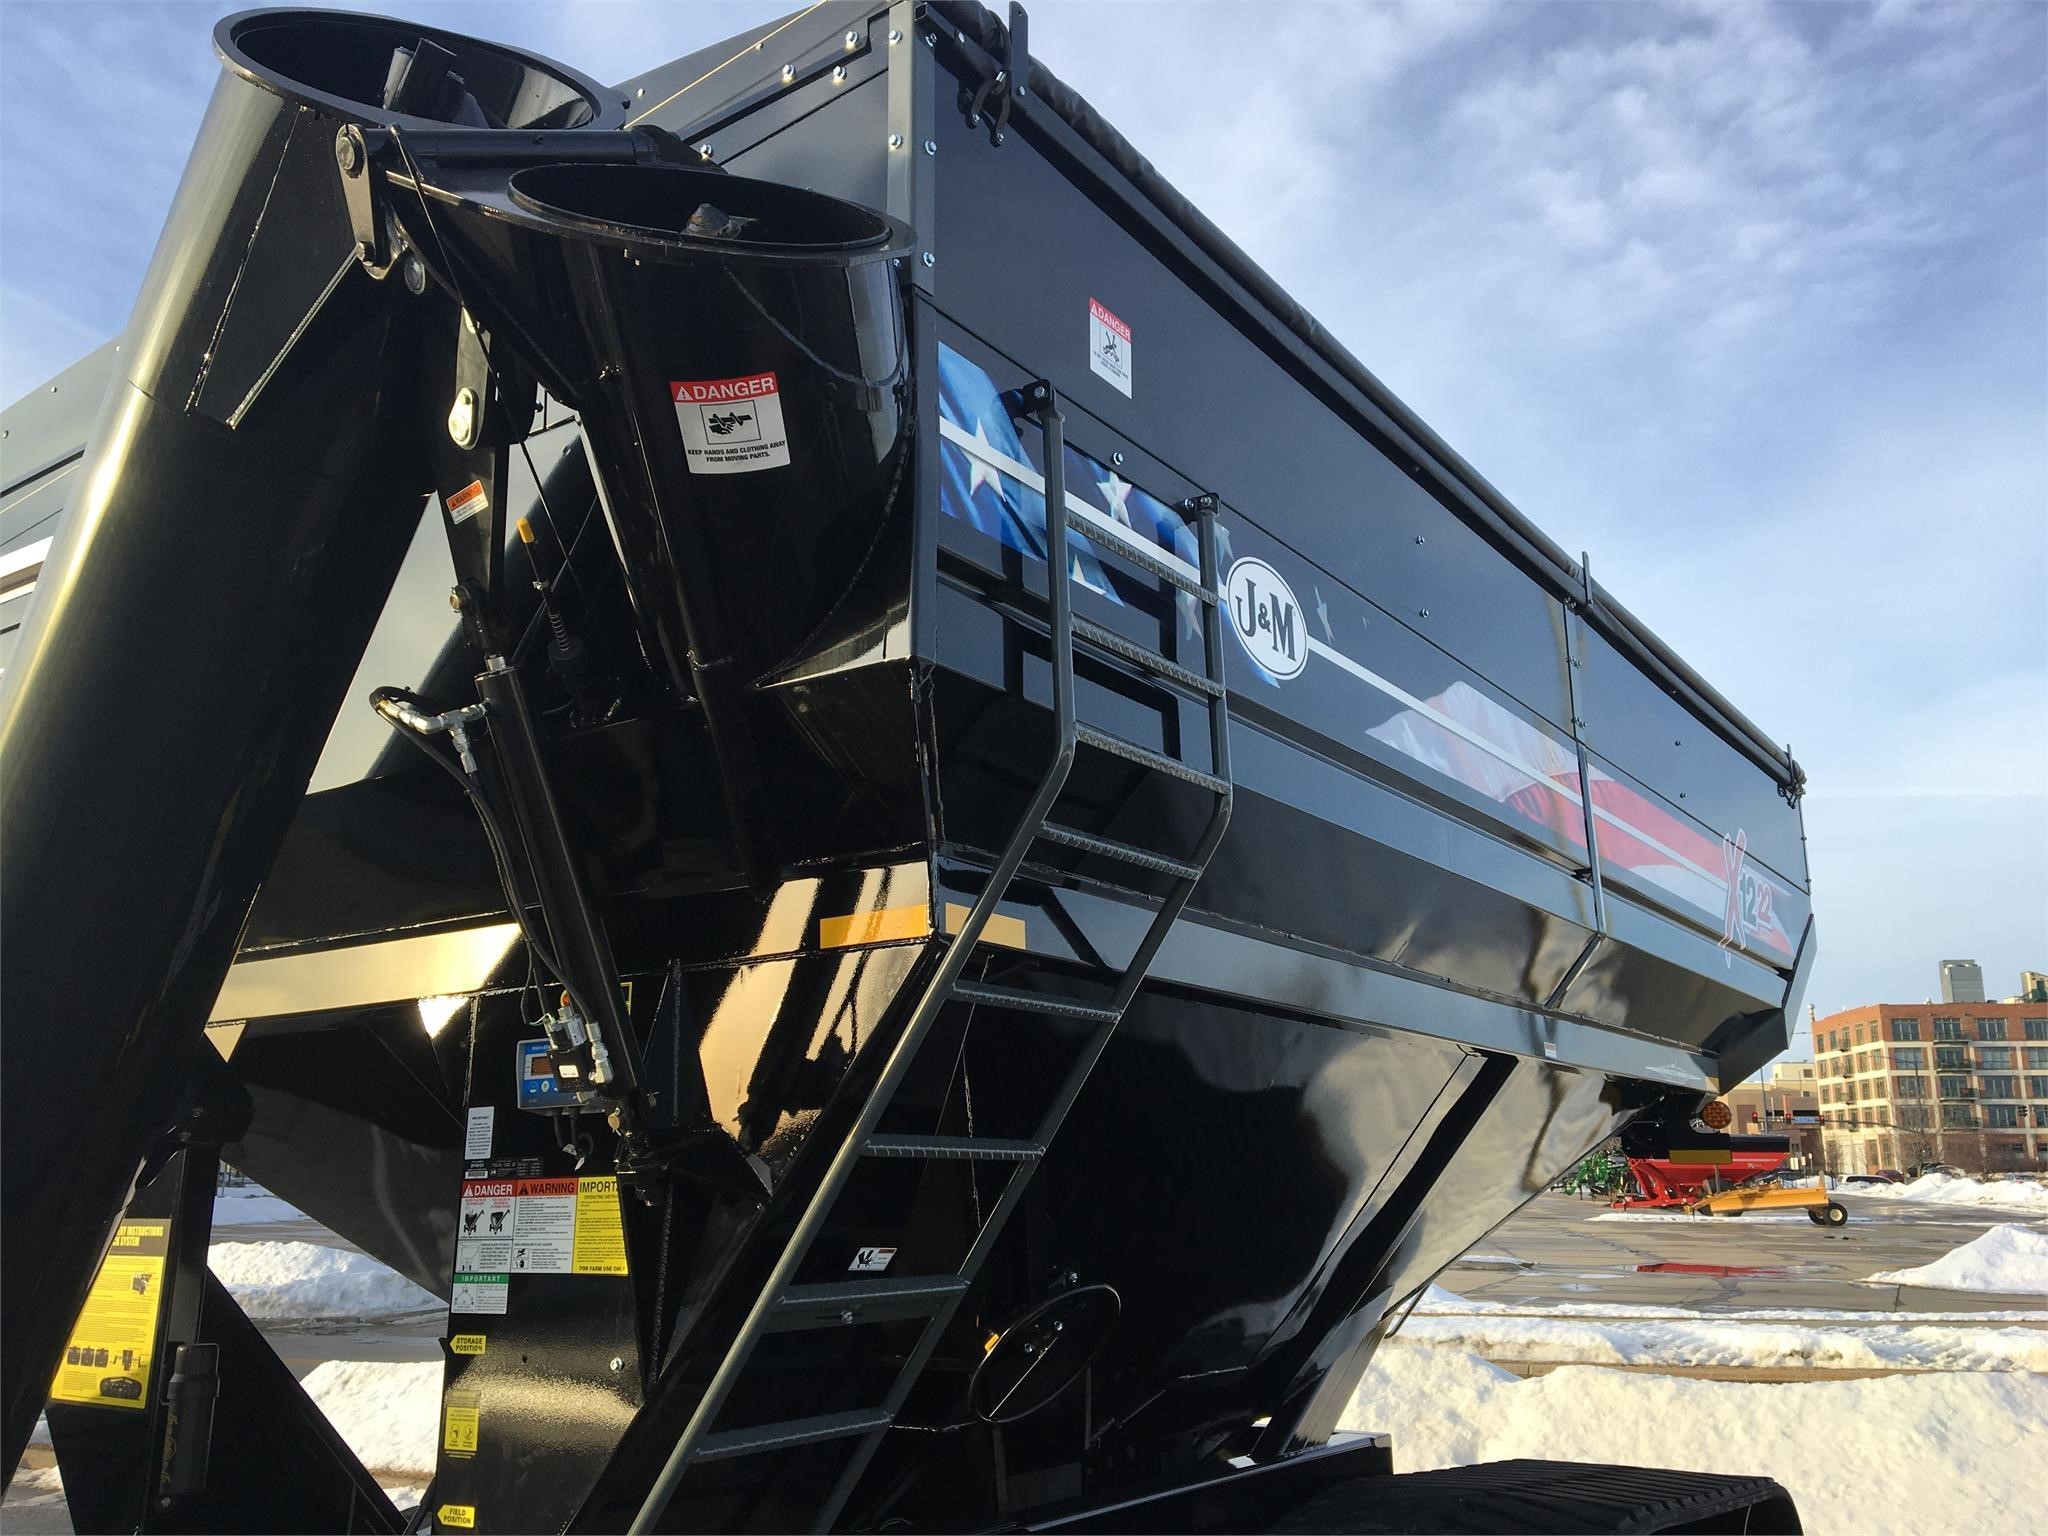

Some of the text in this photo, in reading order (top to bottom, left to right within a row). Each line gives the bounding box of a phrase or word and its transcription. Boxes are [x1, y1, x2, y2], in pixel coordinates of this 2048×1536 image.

[1097, 306, 1131, 341] DANGER
[693, 377, 775, 400] DANGER
[740, 444, 769, 453] CLOTHING
[769, 440, 786, 449] AWAY
[749, 451, 770, 459] PARTS.
[1235, 577, 1297, 662] J&M
[474, 1184, 513, 1196] DANGER
[530, 1182, 575, 1194] WARNING
[127, 1226, 164, 1237] INSTRUCTIONS
[456, 1337, 483, 1345] STORAGE
[455, 1344, 483, 1352] POSITION
[449, 1508, 466, 1516] FIELD
[443, 1515, 471, 1525] POSITION
